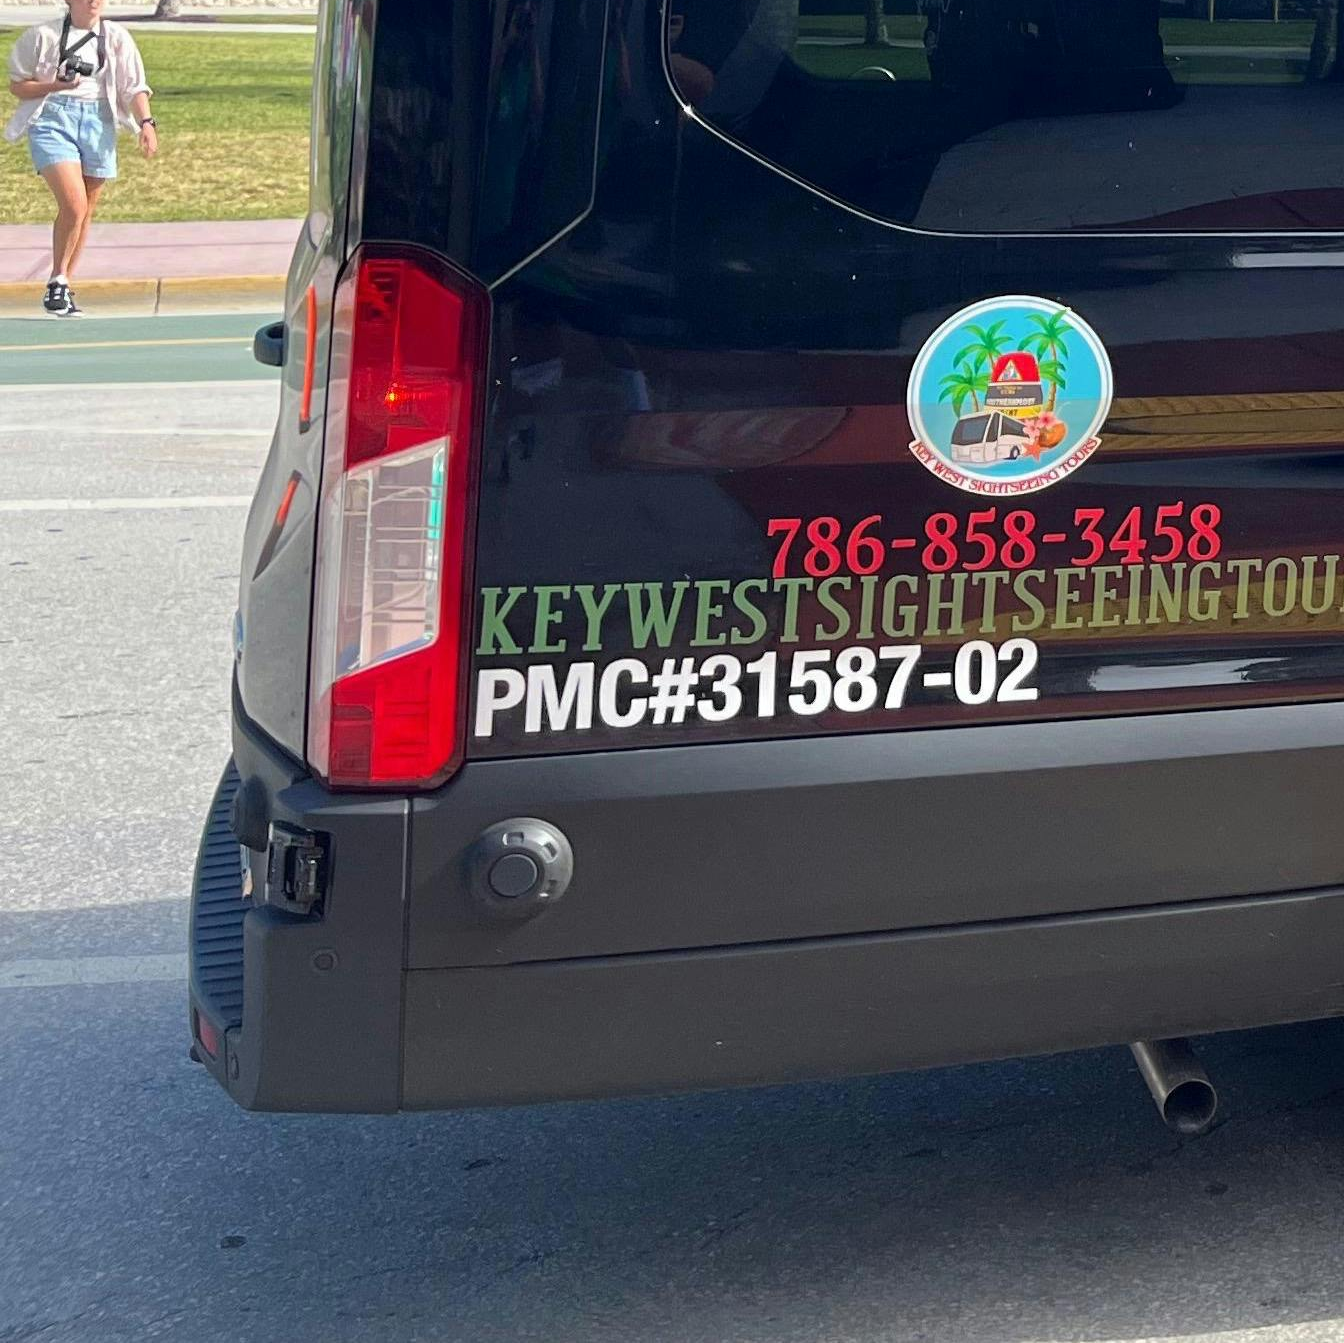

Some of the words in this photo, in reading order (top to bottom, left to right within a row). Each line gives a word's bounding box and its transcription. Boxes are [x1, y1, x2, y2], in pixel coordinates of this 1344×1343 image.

[913, 442, 937, 464] KEY
[935, 461, 969, 487] WEST
[968, 468, 1060, 494] SIGHTSEEING
[1060, 437, 1098, 472] TOURS
[766, 500, 1222, 580] 786-858-3458
[473, 637, 1039, 738] PMC#31587-02
